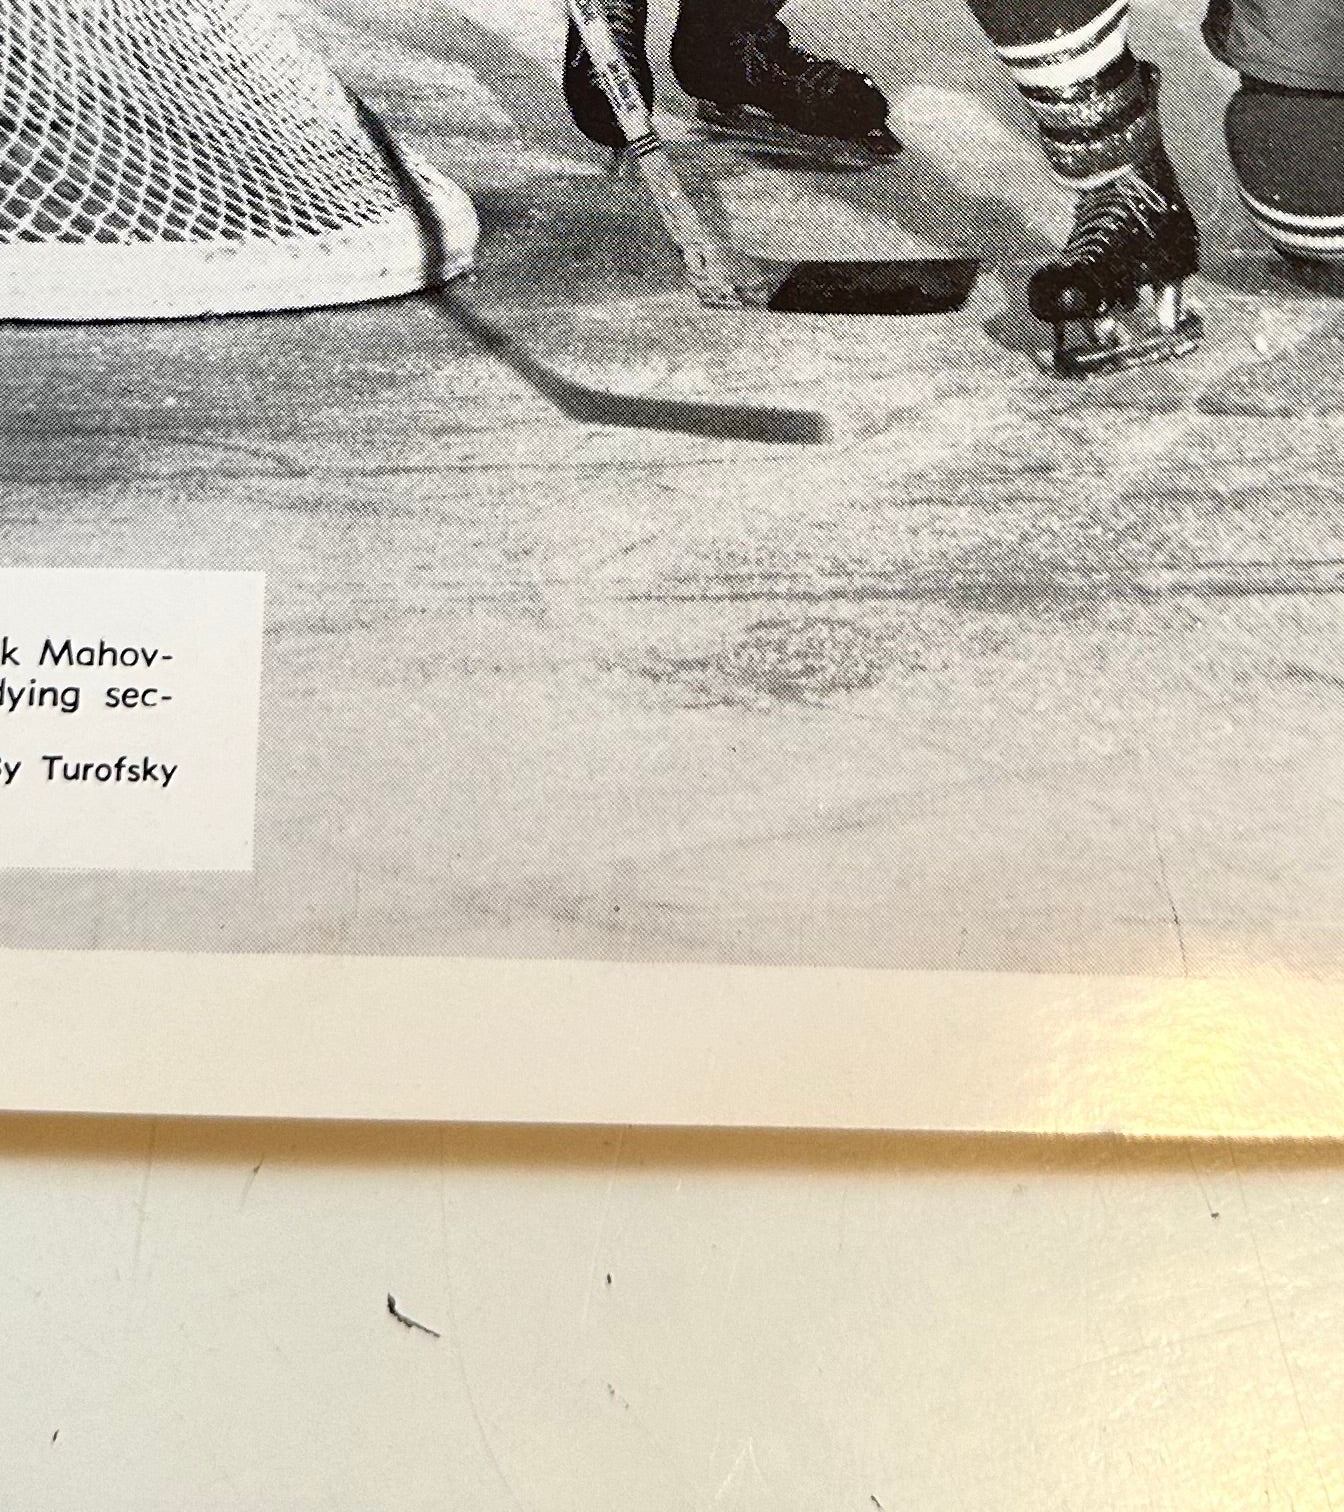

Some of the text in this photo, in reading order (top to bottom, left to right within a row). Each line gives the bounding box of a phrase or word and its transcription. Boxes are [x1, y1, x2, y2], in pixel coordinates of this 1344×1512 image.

[38, 638, 173, 668] Mahov-
[105, 687, 172, 708] sec-
[41, 755, 178, 788] Turofsky
